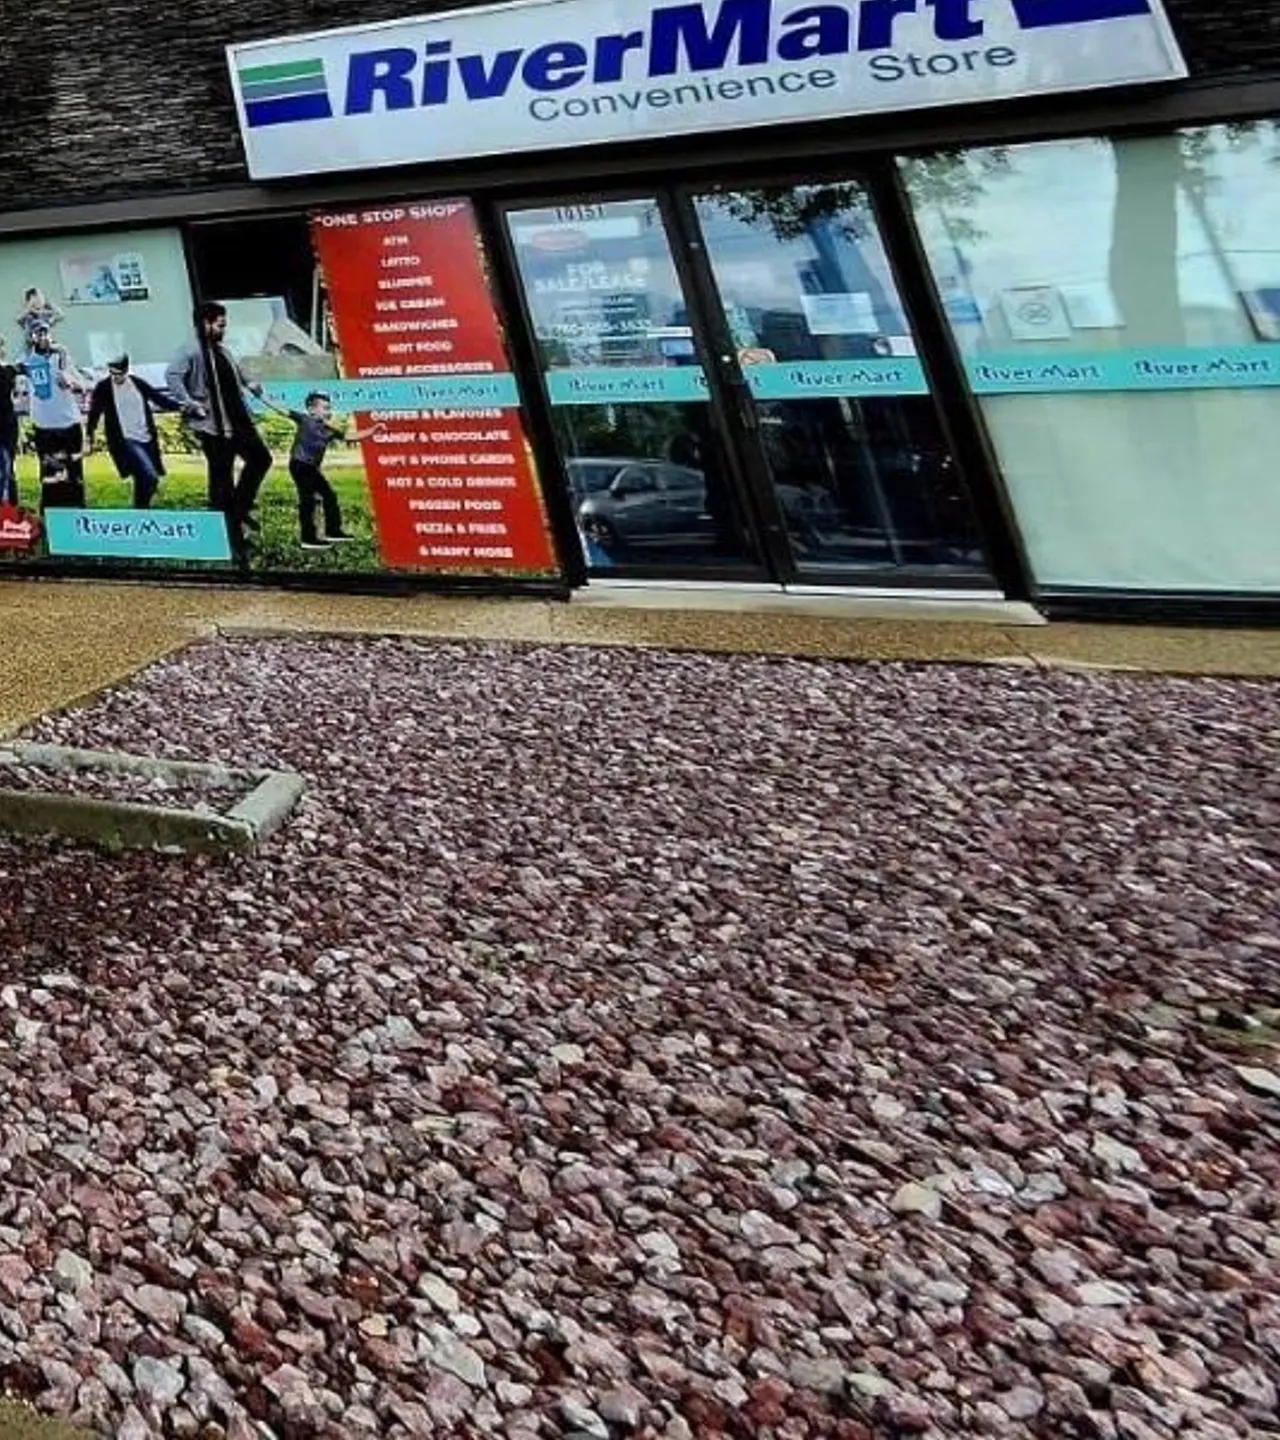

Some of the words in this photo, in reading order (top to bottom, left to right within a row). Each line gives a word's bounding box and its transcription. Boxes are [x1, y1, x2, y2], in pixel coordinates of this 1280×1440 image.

[528, 68, 838, 122] Convenience
[868, 45, 1018, 83] Store
[362, 208, 406, 224] STOP
[400, 297, 446, 309] CREAM
[372, 319, 459, 333] SANDWICHES
[387, 342, 413, 354] HOT
[415, 340, 453, 353] FOOD
[358, 365, 402, 377] PHONE
[405, 361, 494, 376] ACCESSORIES
[975, 363, 1033, 380] River
[1042, 363, 1101, 379] Mart
[1135, 358, 1198, 376] River
[1208, 356, 1272, 373] Mart
[790, 368, 843, 386] River
[851, 367, 902, 384] Mart
[430, 429, 512, 442] CHOCOLATE
[421, 454, 468, 465] PHONE
[469, 453, 516, 465] CARDS
[387, 477, 413, 488] HOT
[427, 477, 463, 488] COLD
[408, 499, 461, 511] FROZEN
[464, 499, 503, 510] FOOD
[76, 515, 130, 537] River
[139, 516, 197, 538] Mart
[415, 523, 454, 535] PIZZA
[430, 546, 471, 556] MANY
